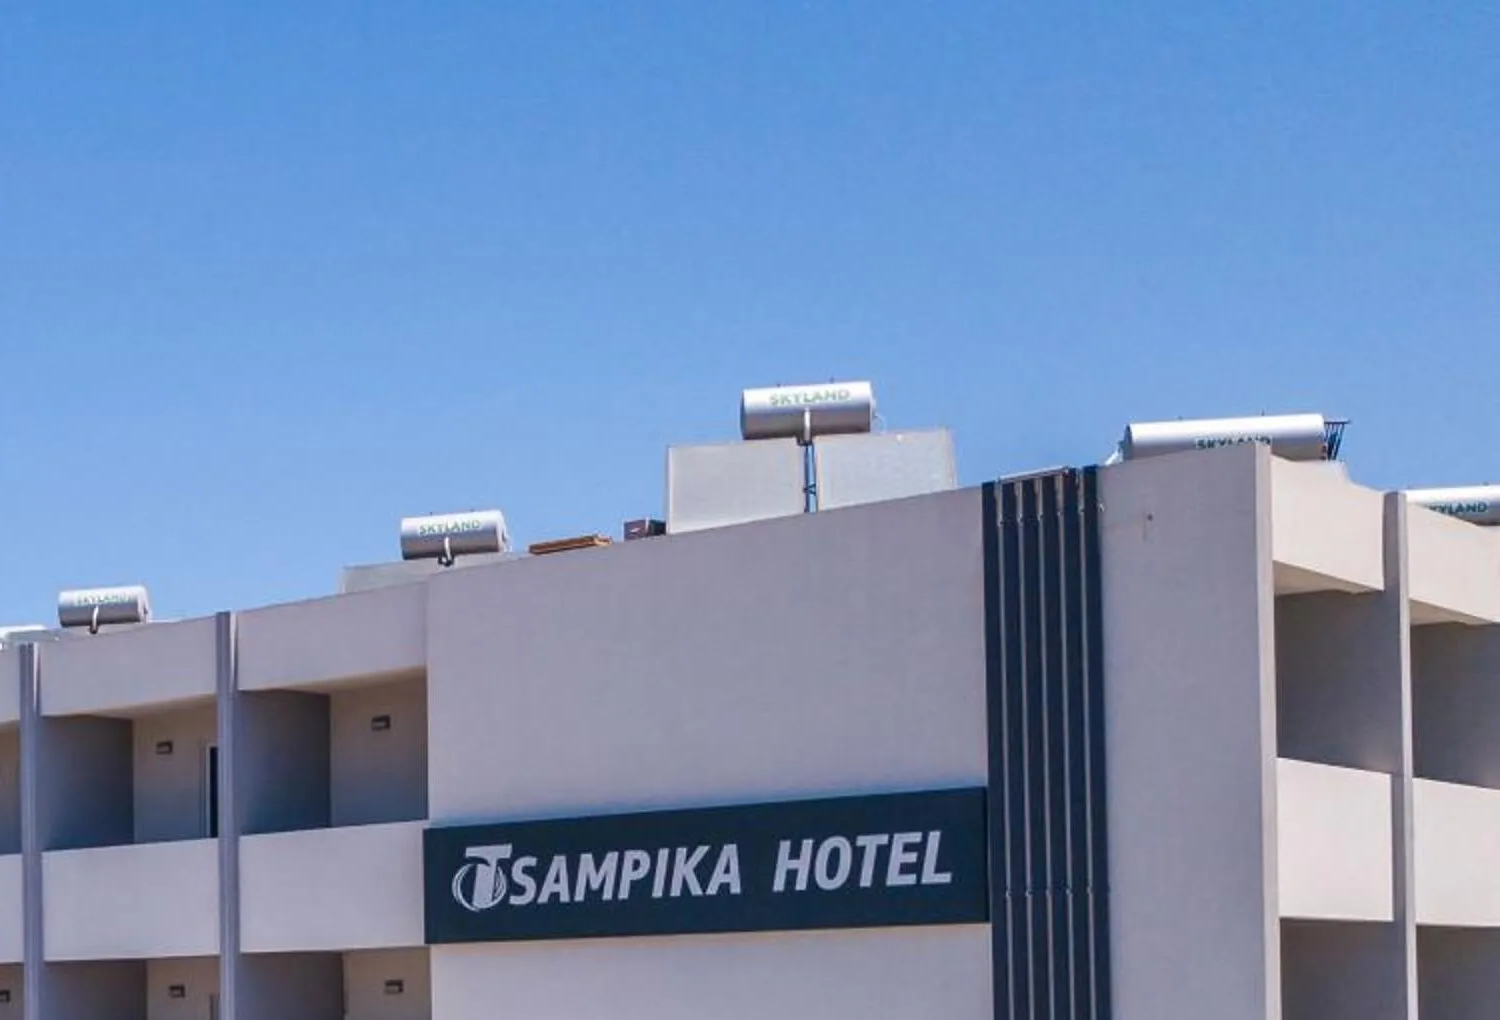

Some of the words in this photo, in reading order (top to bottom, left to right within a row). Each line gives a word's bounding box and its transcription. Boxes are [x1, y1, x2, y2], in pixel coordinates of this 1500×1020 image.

[770, 389, 850, 405] SKYLAND
[419, 519, 481, 535] SKYLAND
[452, 844, 742, 912] TSAMPIKA
[772, 831, 953, 892] HOTEL
